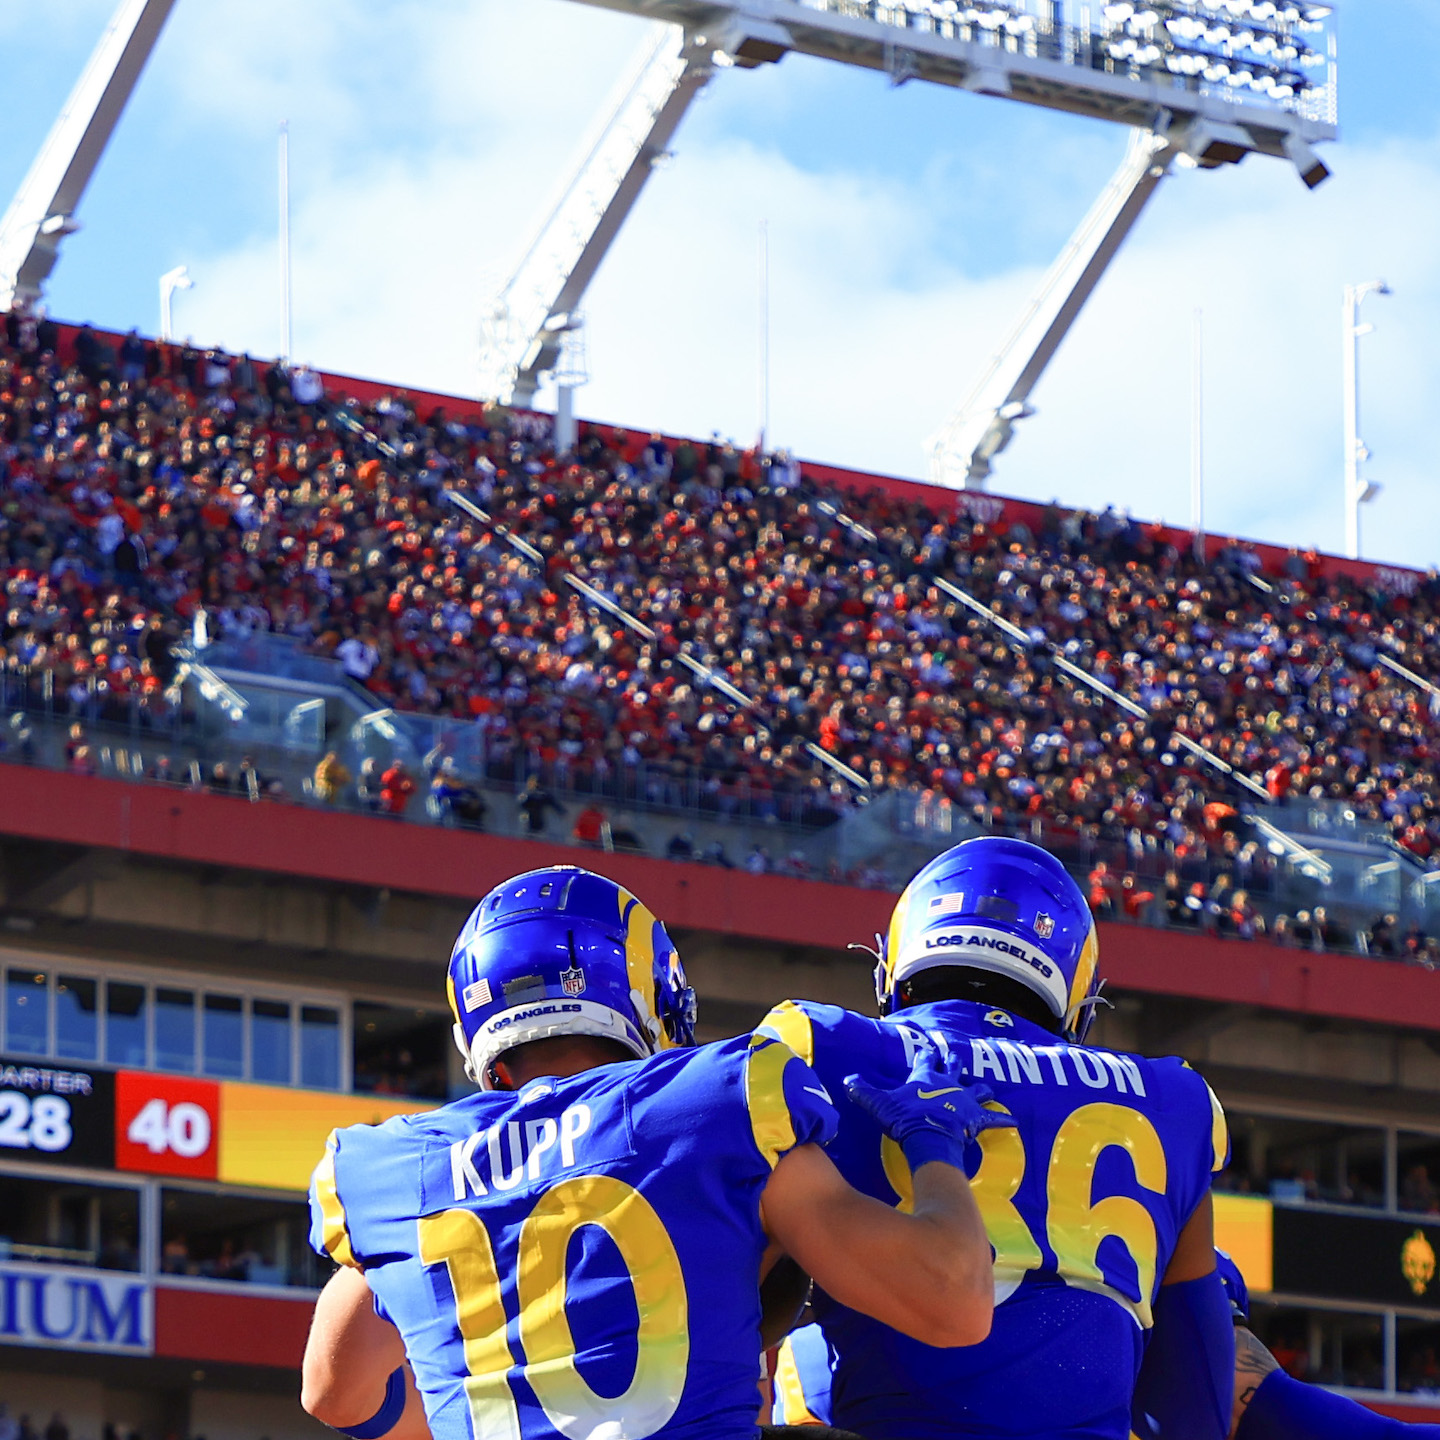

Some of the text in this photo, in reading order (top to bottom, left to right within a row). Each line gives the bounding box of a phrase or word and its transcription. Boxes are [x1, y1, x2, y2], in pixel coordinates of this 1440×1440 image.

[926, 935, 1053, 979] LOS ANGELES
[564, 979, 585, 995] NFL
[487, 1003, 582, 1034] LOS ANGELES
[127, 1098, 212, 1158] 40
[449, 1103, 591, 1202] KUPP
